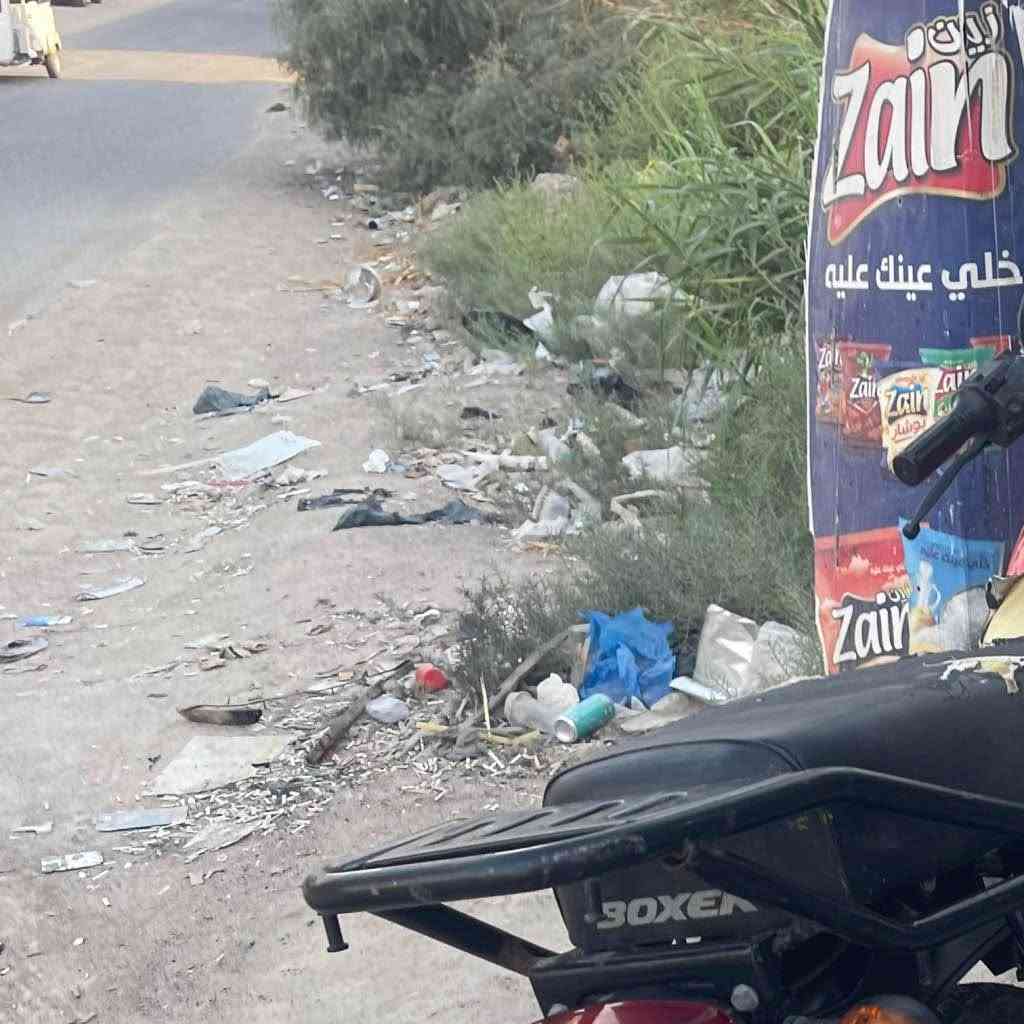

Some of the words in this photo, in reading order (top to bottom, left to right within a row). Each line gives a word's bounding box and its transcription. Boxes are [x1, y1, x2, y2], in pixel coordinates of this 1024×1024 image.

[822, 27, 1015, 207] Zain
[825, 254, 870, 299] عليه
[876, 254, 934, 301] عينك
[941, 250, 1024, 301] خلي
